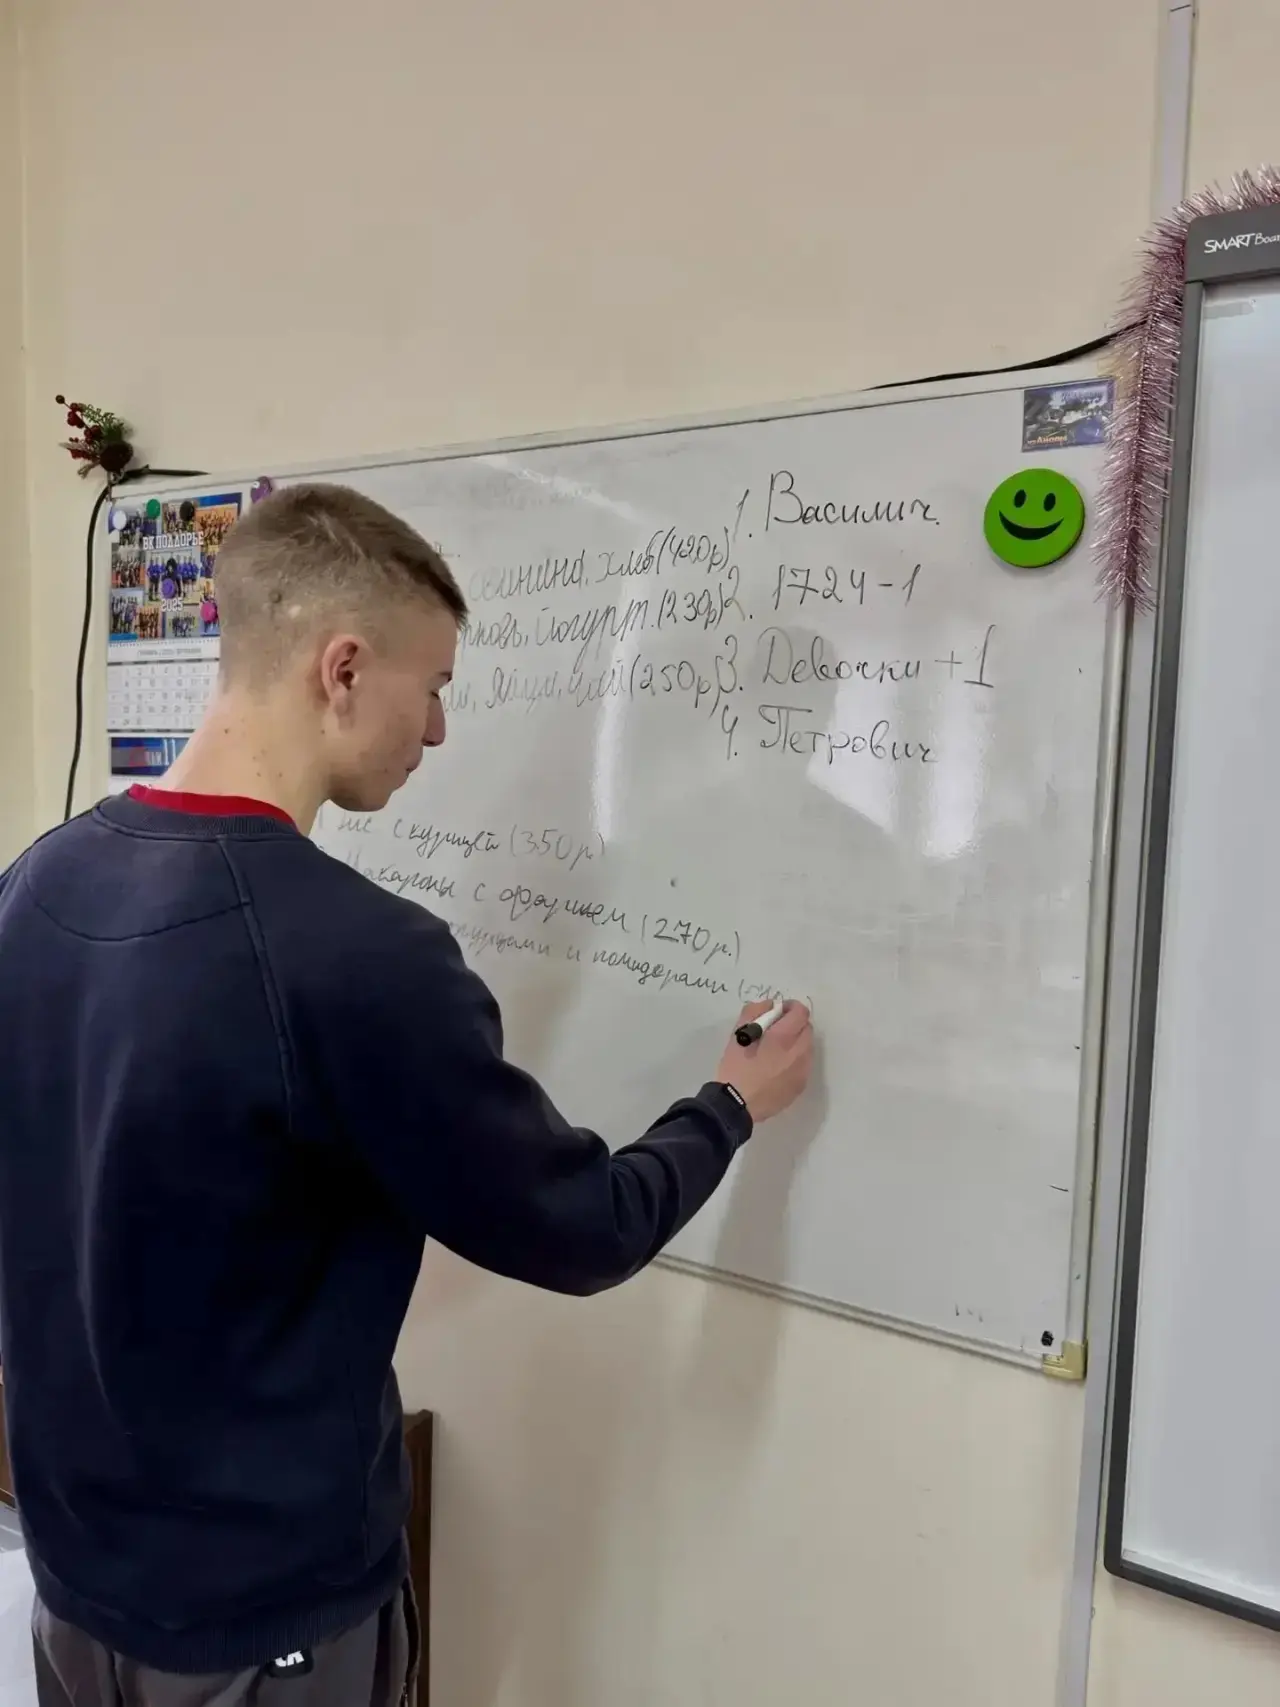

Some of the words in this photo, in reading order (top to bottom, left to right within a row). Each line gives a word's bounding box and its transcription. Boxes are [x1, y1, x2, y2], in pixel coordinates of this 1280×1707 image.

[1203, 232, 1256, 254] SMART
[142, 535, 156, 551] ВК
[155, 531, 205, 549] ПОДДОРЬЕ
[732, 488, 754, 543] 1.
[160, 597, 184, 613] 2025
[724, 565, 754, 622] 2.
[721, 634, 744, 694] 3.
[757, 626, 922, 686] Девочки
[720, 704, 740, 761] 4.
[757, 703, 938, 766] Петрович
